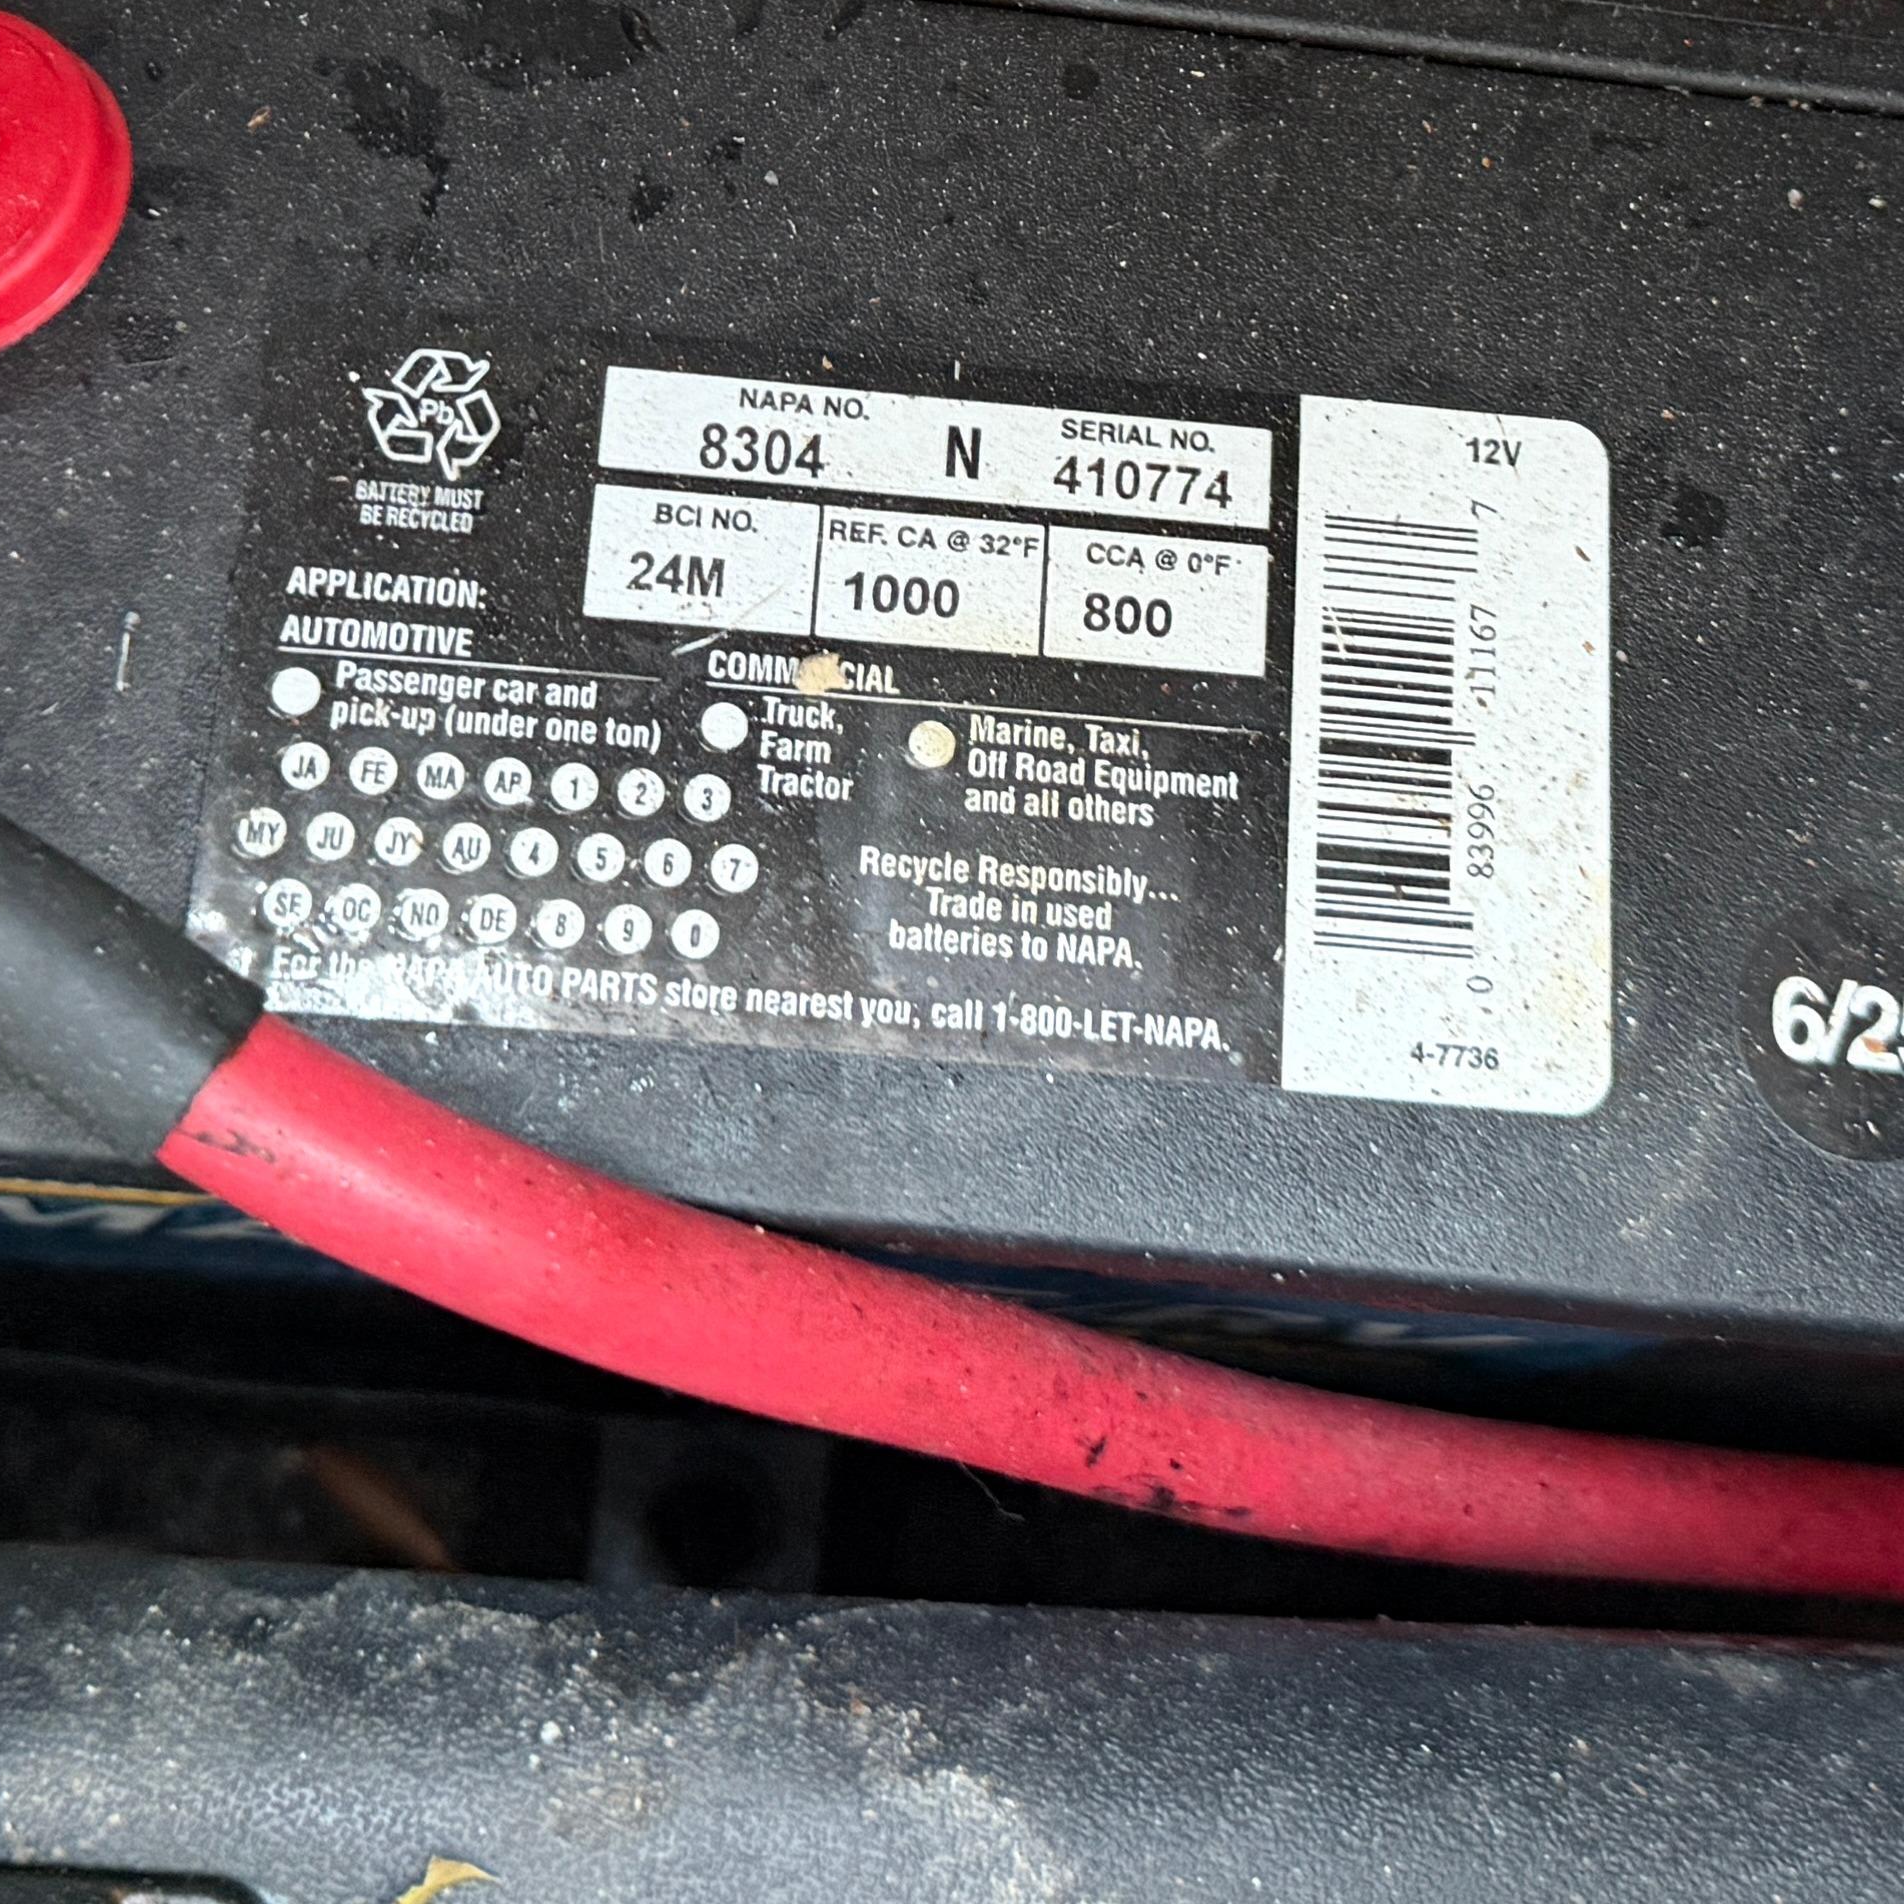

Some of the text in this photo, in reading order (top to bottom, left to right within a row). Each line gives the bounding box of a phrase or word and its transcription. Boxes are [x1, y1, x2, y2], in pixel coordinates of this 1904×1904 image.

[419, 398, 455, 425] Pb
[739, 387, 871, 421] NAPA NO.
[1060, 417, 1217, 454] SERIAL NO.
[1465, 437, 1523, 468] 12V
[698, 422, 1234, 510] 8304 N 410774
[354, 478, 485, 511] BATTERY MUST
[1469, 498, 1499, 523] 7
[359, 504, 475, 535] BE RECYCLED
[652, 502, 758, 534] BCI NO.
[829, 519, 1041, 559] REF. CA @ 32°F
[626, 550, 727, 598] 24M
[1086, 542, 1232, 576] CCA @ 0°F
[285, 565, 487, 610] APPLICATION:
[843, 571, 961, 619] 1000
[279, 613, 475, 658] AUTOMOTIVE
[1082, 592, 1174, 639] 800
[707, 649, 900, 694] COMMCIAL
[1469, 603, 1498, 698] 11167
[335, 659, 598, 711] Passenger car and
[329, 696, 663, 756] pick-up (under one ton)
[762, 696, 844, 735] Truck,
[969, 712, 1150, 761] Marine, Taxi,
[759, 730, 832, 765] Farm
[291, 754, 714, 812] JA FE MA AP 1 2 3
[756, 763, 854, 802] Tractor
[968, 751, 1240, 802] Off Road Equipment
[964, 785, 1156, 828] and all others
[245, 820, 741, 882] MY JU JY AU 4 5 6 7
[1467, 783, 1498, 880] 83996
[859, 844, 1182, 904] Recycle Responsibly...
[274, 891, 303, 917] SE
[342, 896, 372, 923] OC
[410, 901, 440, 927] NO
[479, 907, 508, 933] DE
[554, 913, 567, 938] 8
[622, 918, 635, 943] 9
[925, 885, 1112, 931] Trade in used
[889, 918, 1143, 970] batteries to NAPA.
[270, 945, 322, 980] For
[470, 959, 554, 999] AUTO
[561, 966, 657, 1005] PARTS
[665, 983, 738, 1018] store
[745, 988, 854, 1024] nearest
[931, 1000, 984, 1032] call
[992, 999, 1232, 1052] 1-800-LET-NAPA.
[1411, 1042, 1500, 1072] 4-7736
